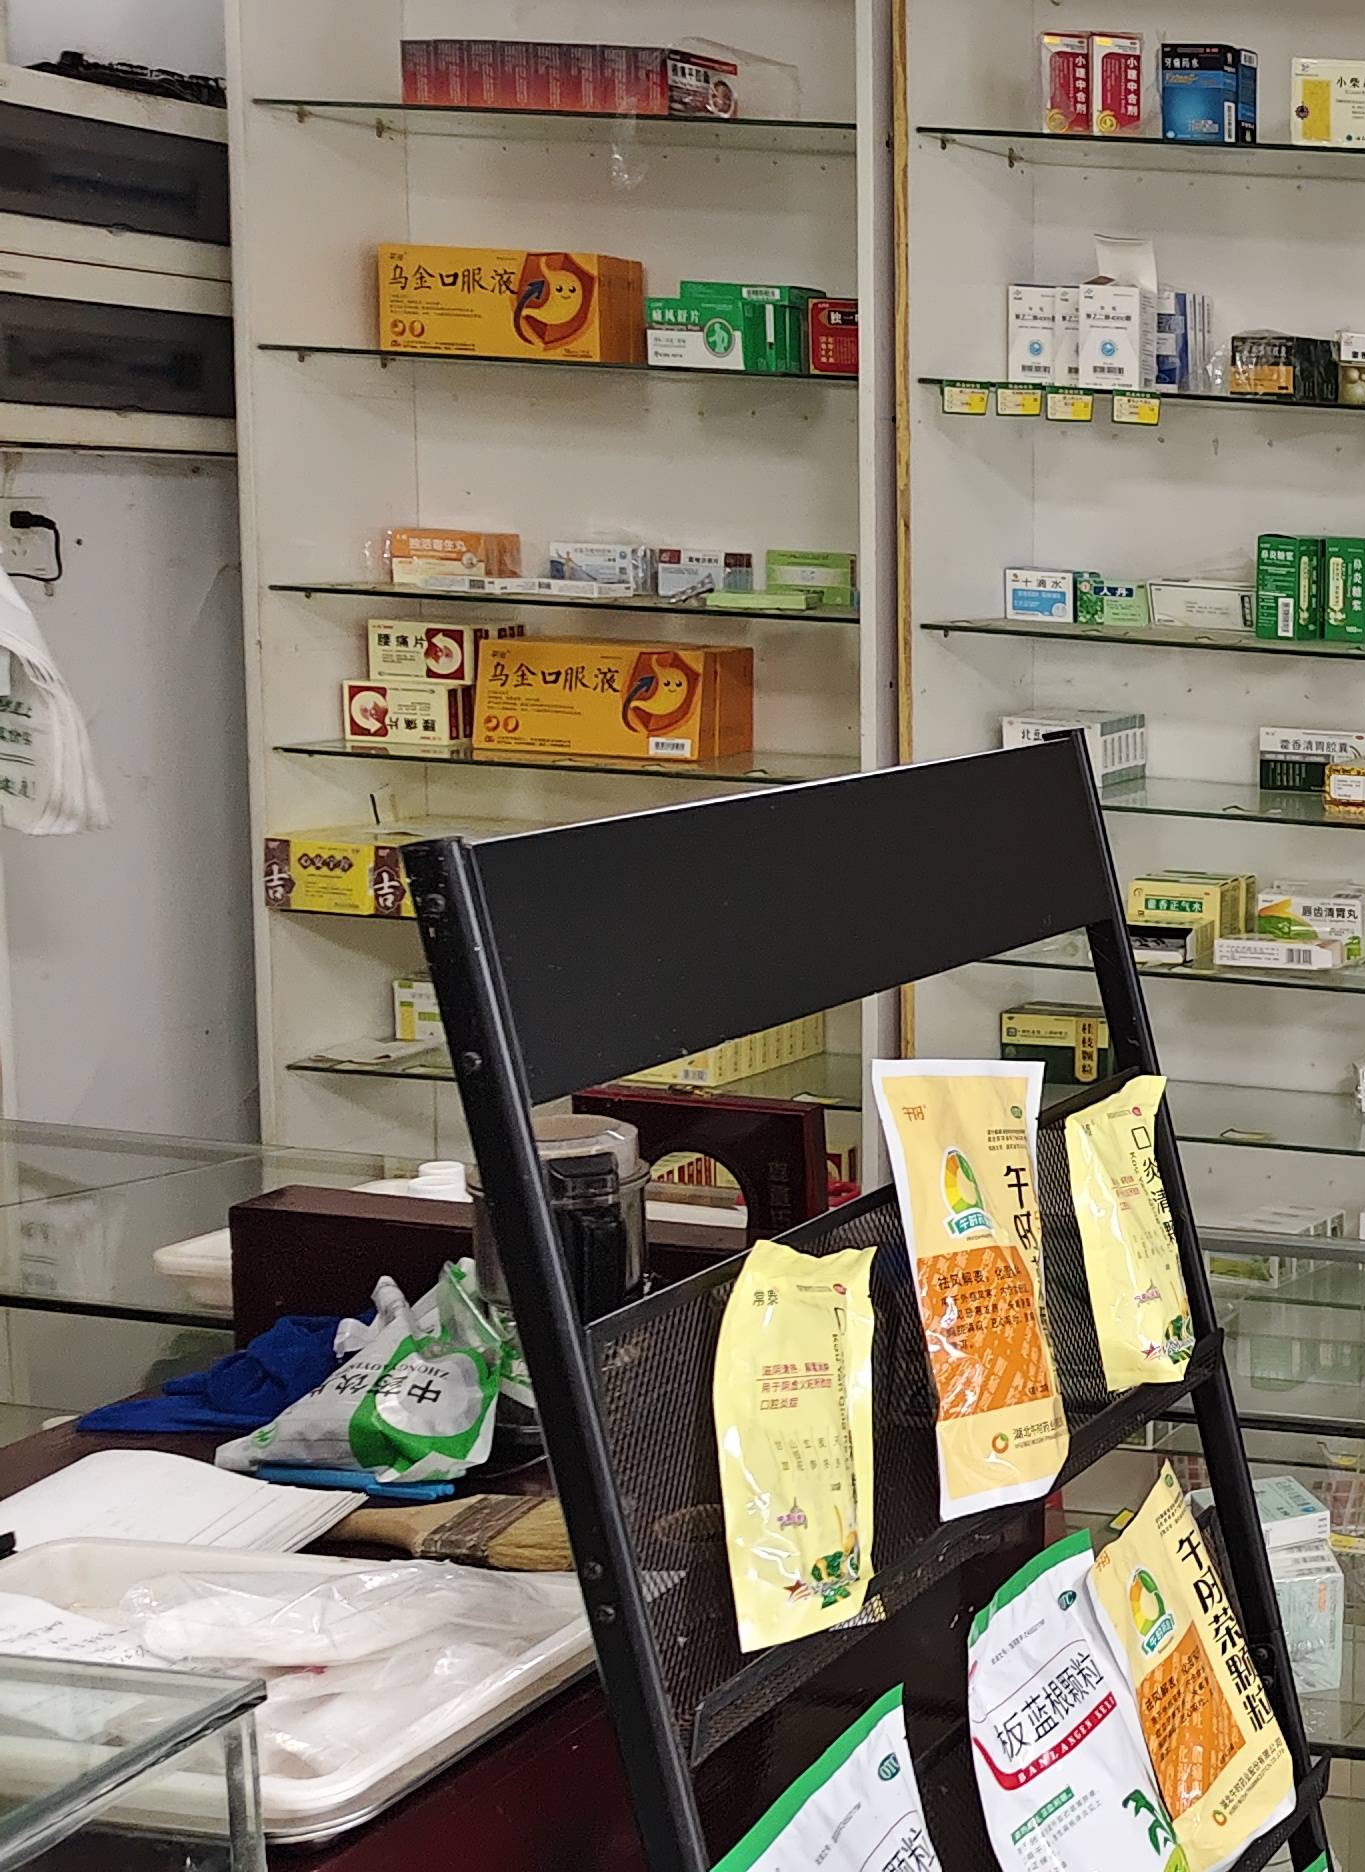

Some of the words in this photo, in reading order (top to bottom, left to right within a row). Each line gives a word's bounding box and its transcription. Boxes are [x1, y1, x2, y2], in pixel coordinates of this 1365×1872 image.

[388, 264, 518, 295] 乌金口服液
[1021, 577, 1063, 591] 十滴水
[488, 662, 622, 693] 乌金口服液
[264, 865, 289, 900] 吉
[374, 872, 399, 908] 吉
[1177, 1530, 1275, 1734] 午时茶颗粒
[993, 1652, 1105, 1763] 板蓝根颗粒
